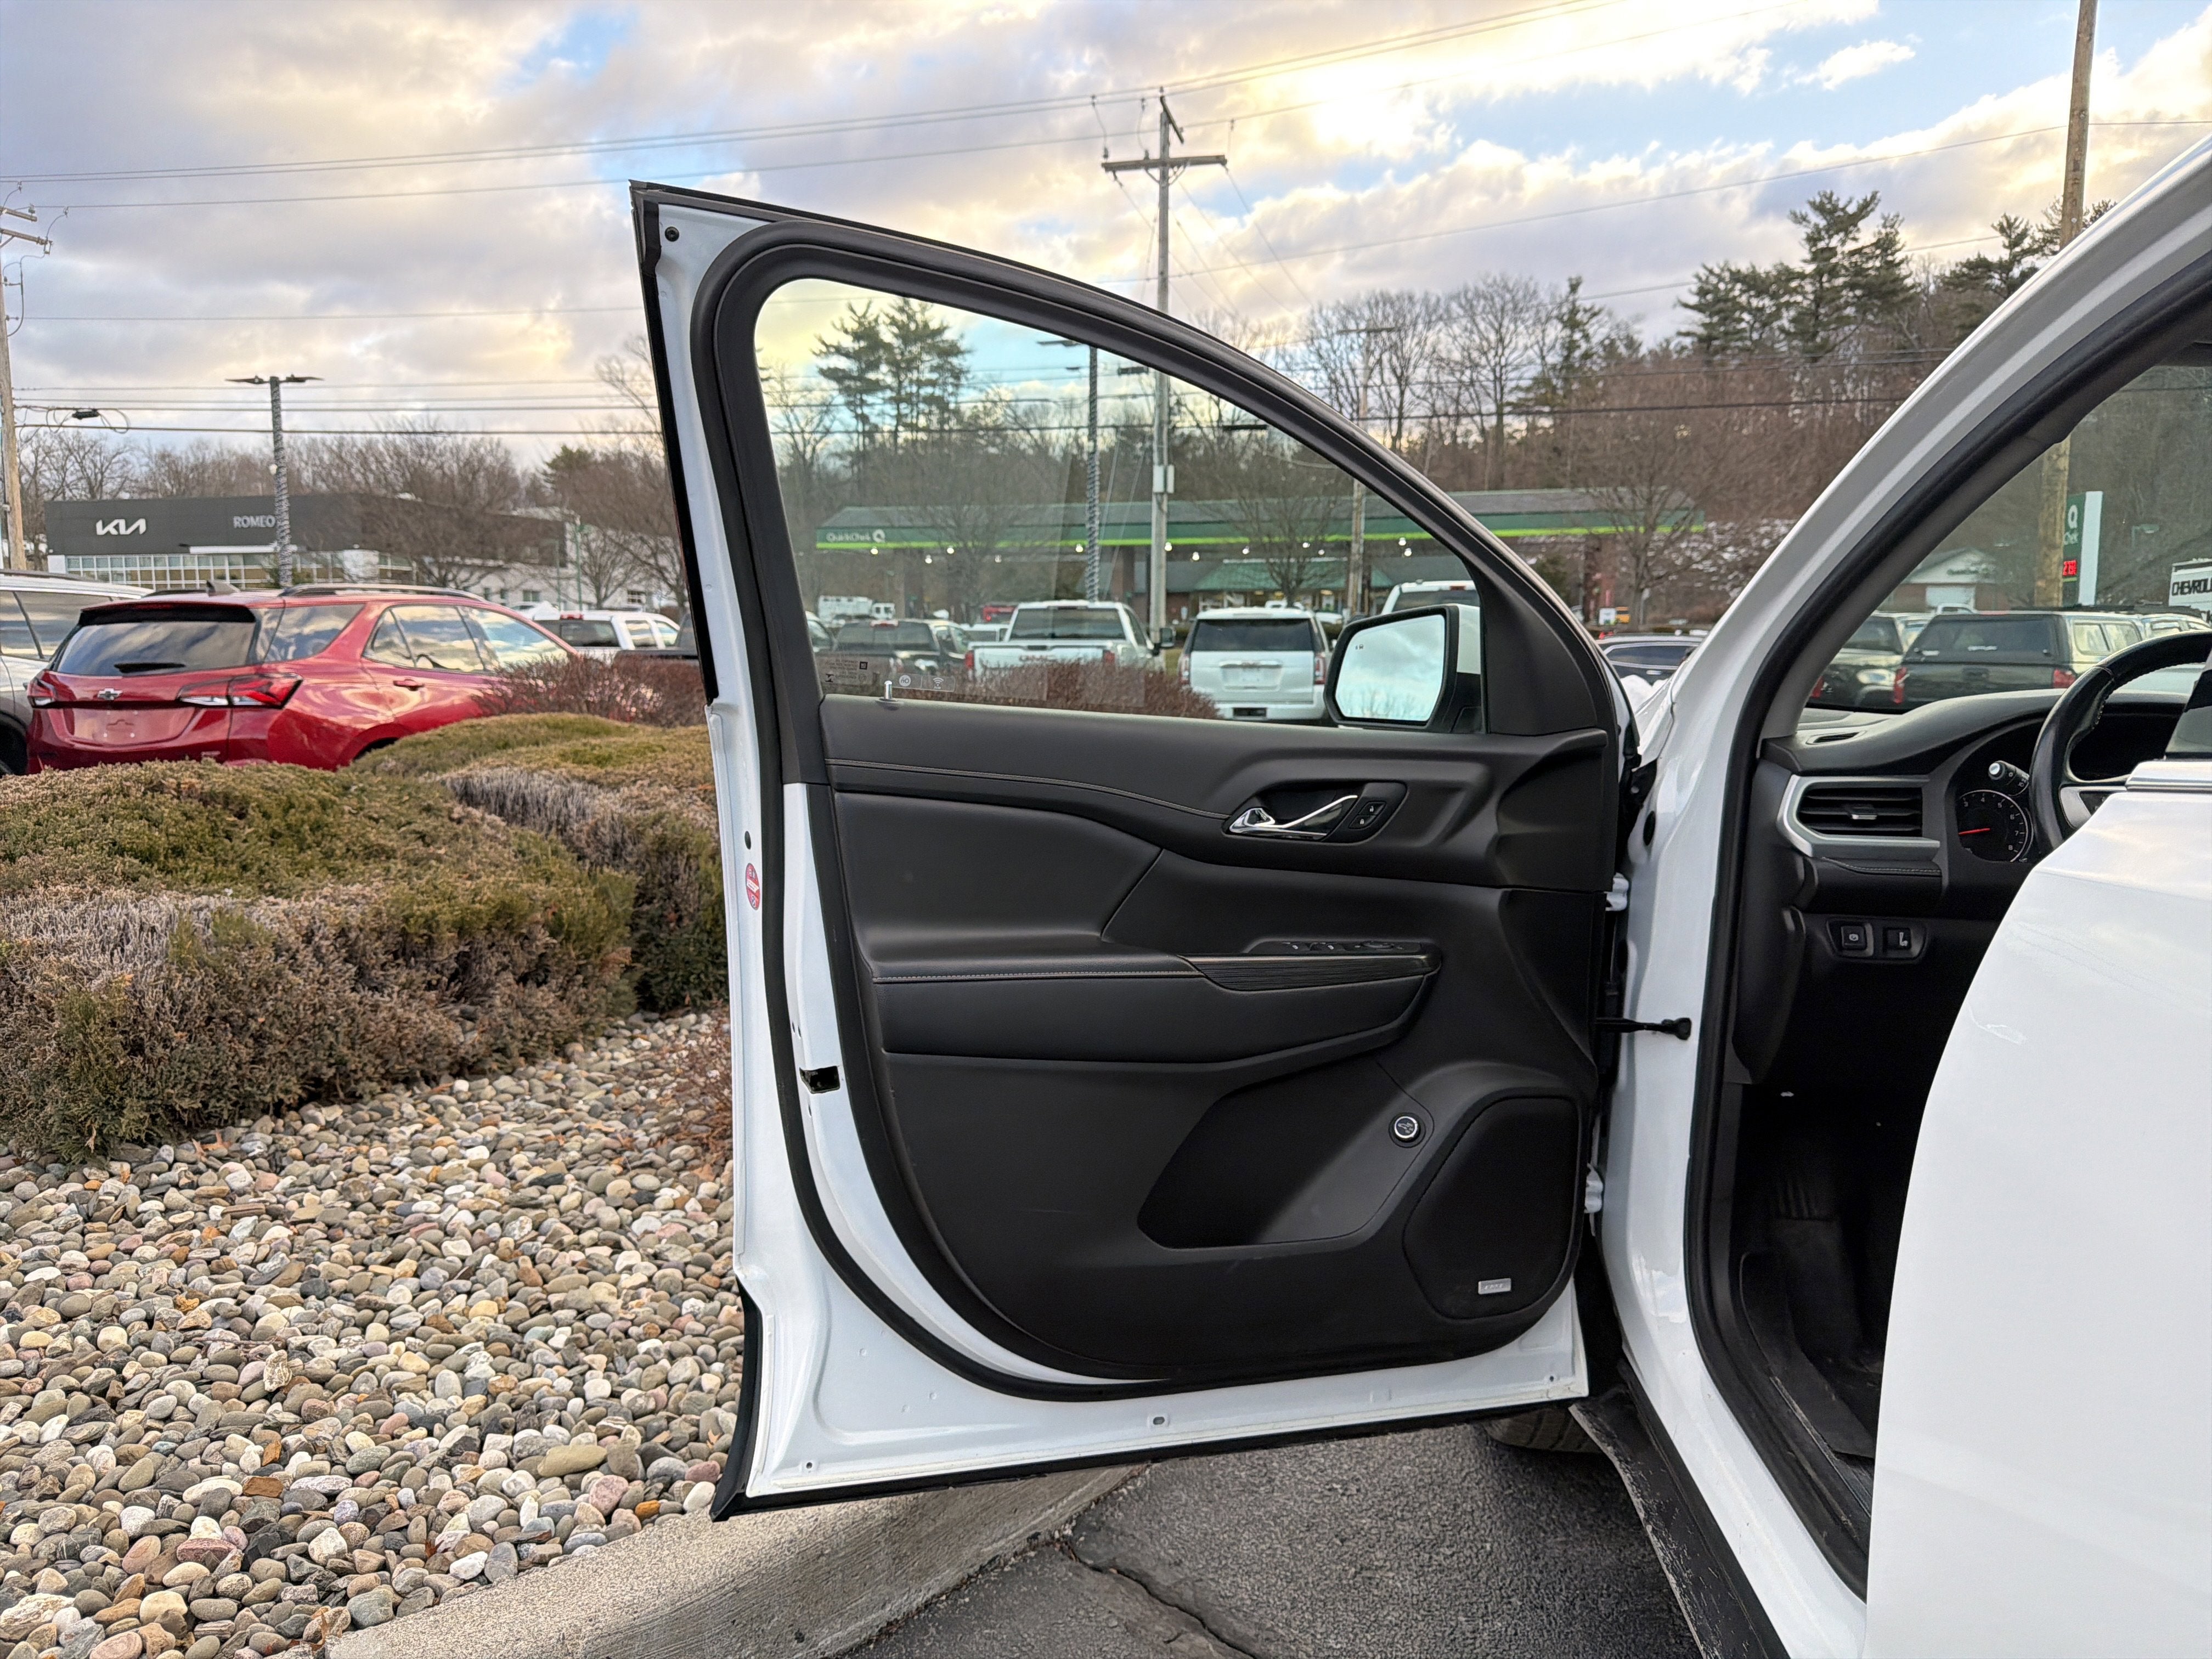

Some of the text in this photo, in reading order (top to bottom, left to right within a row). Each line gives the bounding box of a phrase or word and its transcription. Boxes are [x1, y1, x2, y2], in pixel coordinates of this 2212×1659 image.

[96, 518, 146, 535] KIA
[233, 515, 275, 528] ROMEO
[2172, 577, 2212, 596] CHEVROL
